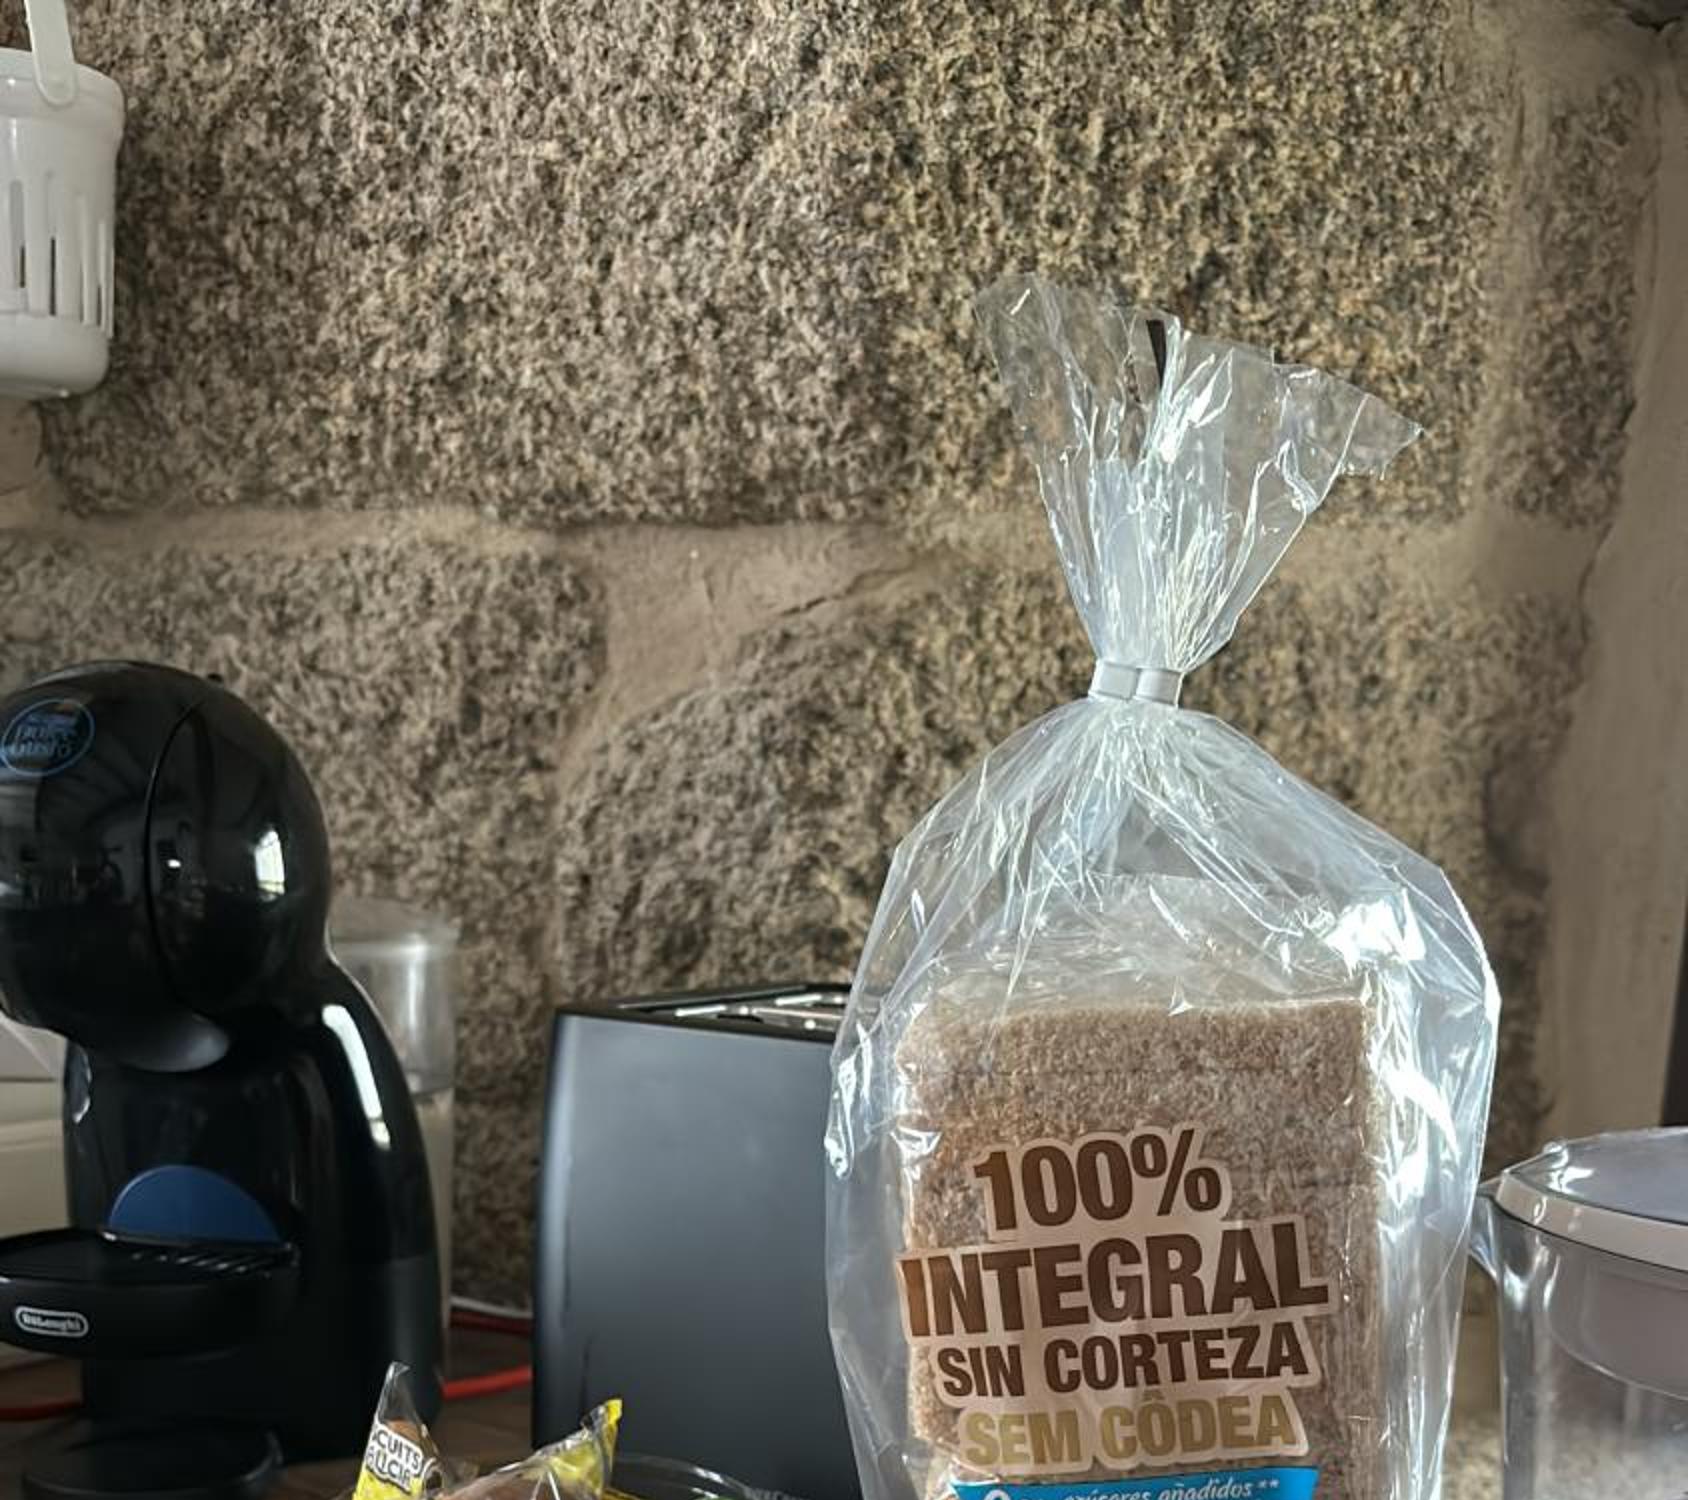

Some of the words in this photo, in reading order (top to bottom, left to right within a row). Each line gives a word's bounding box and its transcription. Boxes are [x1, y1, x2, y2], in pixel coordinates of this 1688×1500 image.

[974, 1129, 1223, 1231] 100%
[900, 1222, 1330, 1337] INTEGRAL
[937, 1346, 1025, 1399] SIN
[1044, 1322, 1309, 1394] CORTEZA
[964, 1408, 1082, 1466] SEM
[1102, 1389, 1293, 1460] CÔDEA
